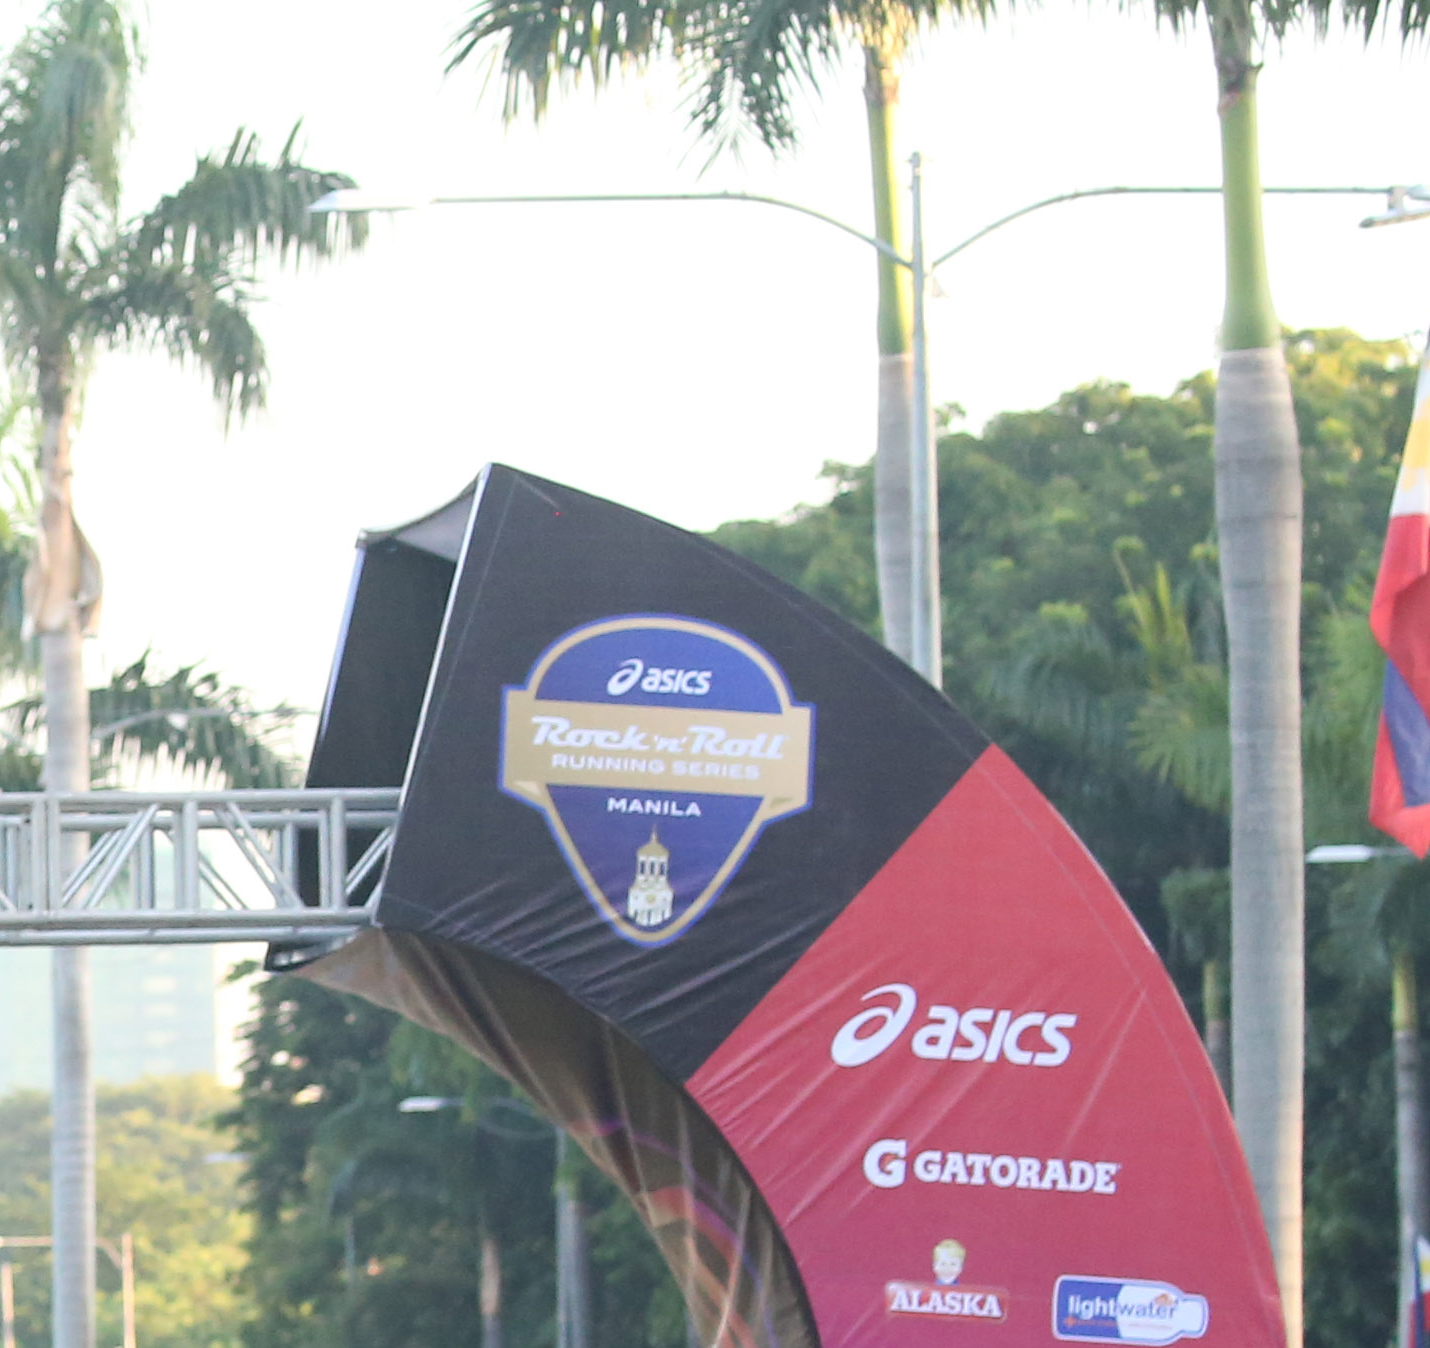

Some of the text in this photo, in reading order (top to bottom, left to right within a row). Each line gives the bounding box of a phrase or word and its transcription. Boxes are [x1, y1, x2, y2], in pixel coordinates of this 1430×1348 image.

[641, 668, 713, 696] asics
[530, 716, 652, 752] Rock
[687, 725, 790, 760] Roll
[551, 752, 761, 780] RUNNING SERIES
[607, 797, 702, 818] MANILA
[910, 1004, 1078, 1068] asics
[914, 1150, 1118, 1195] GATORADE
[889, 1288, 1003, 1319] ALASKA
[1067, 1294, 1179, 1321] lightwater
